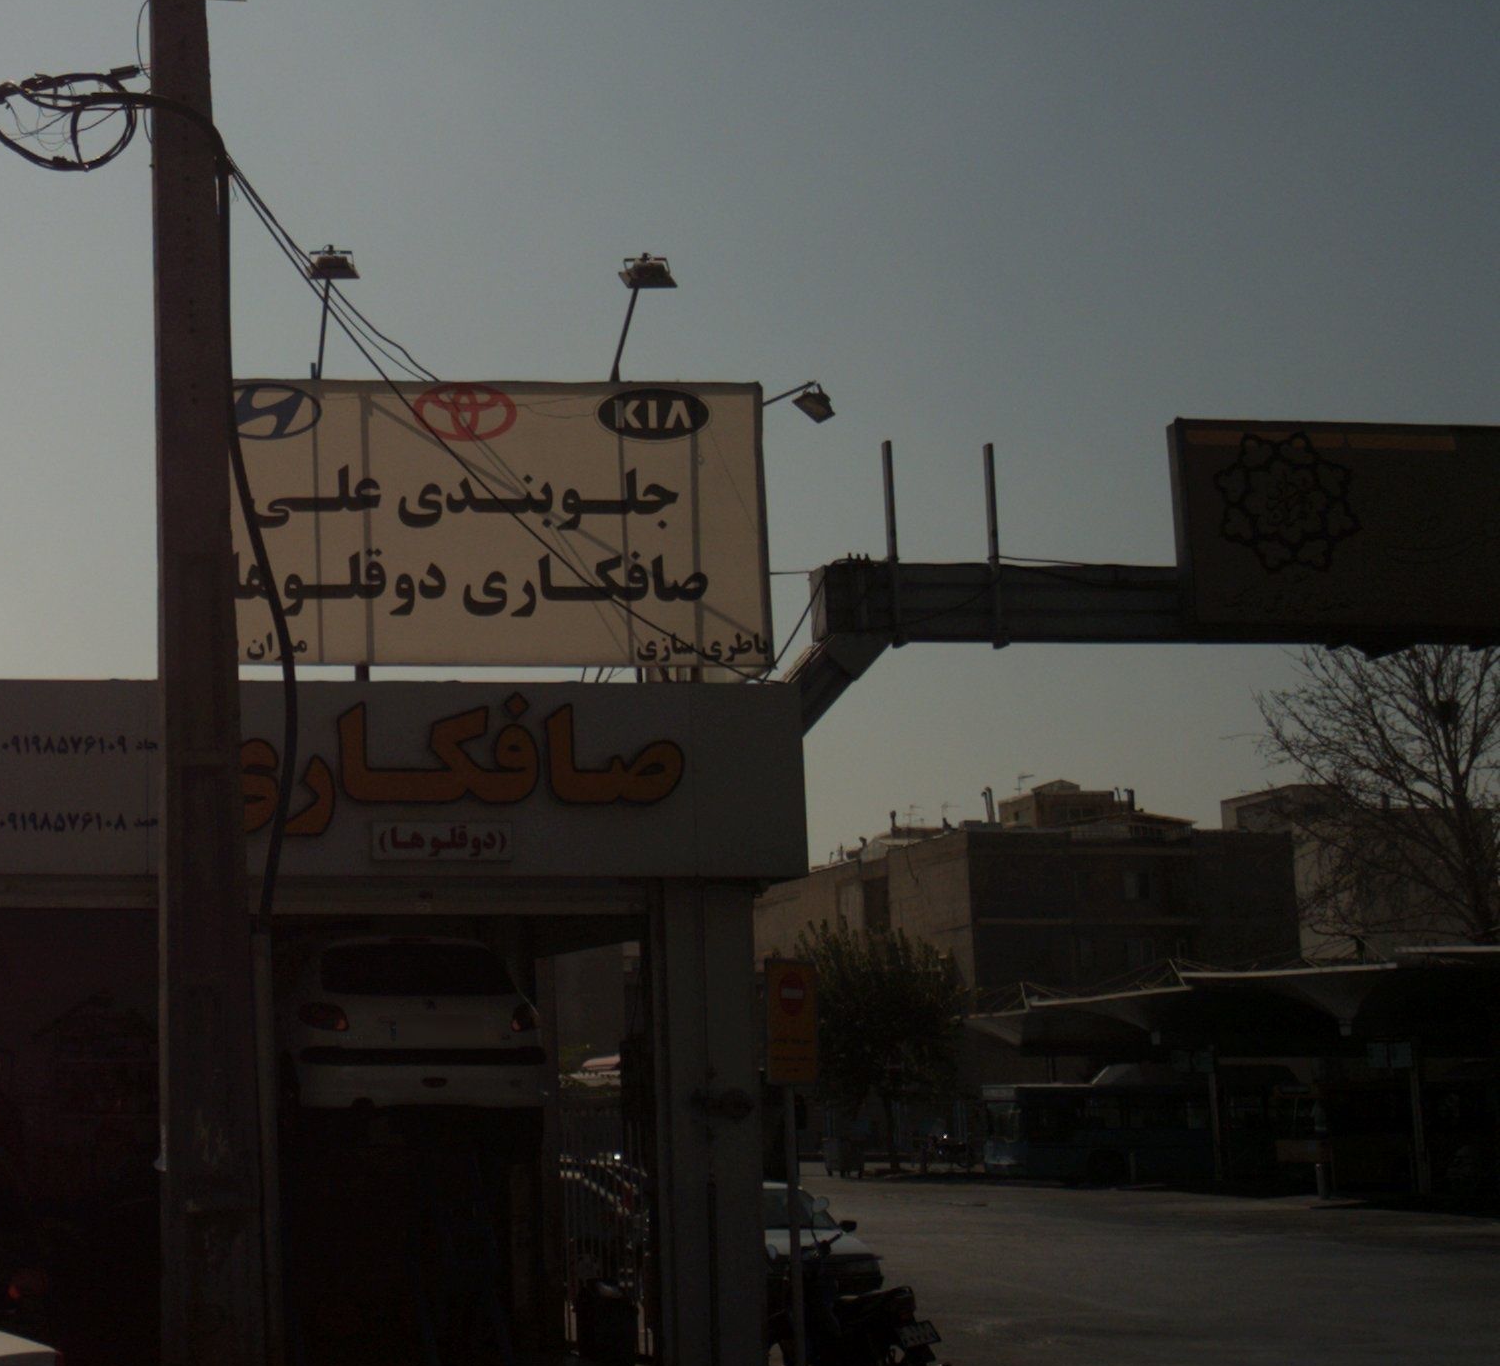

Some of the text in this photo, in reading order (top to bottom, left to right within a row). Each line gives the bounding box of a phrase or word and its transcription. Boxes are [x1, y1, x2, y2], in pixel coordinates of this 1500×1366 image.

[614, 399, 693, 429] KIA
[252, 465, 679, 530] جلوبندی علی
[462, 552, 708, 617] صافکاری
[637, 633, 769, 661] باطری سازی
